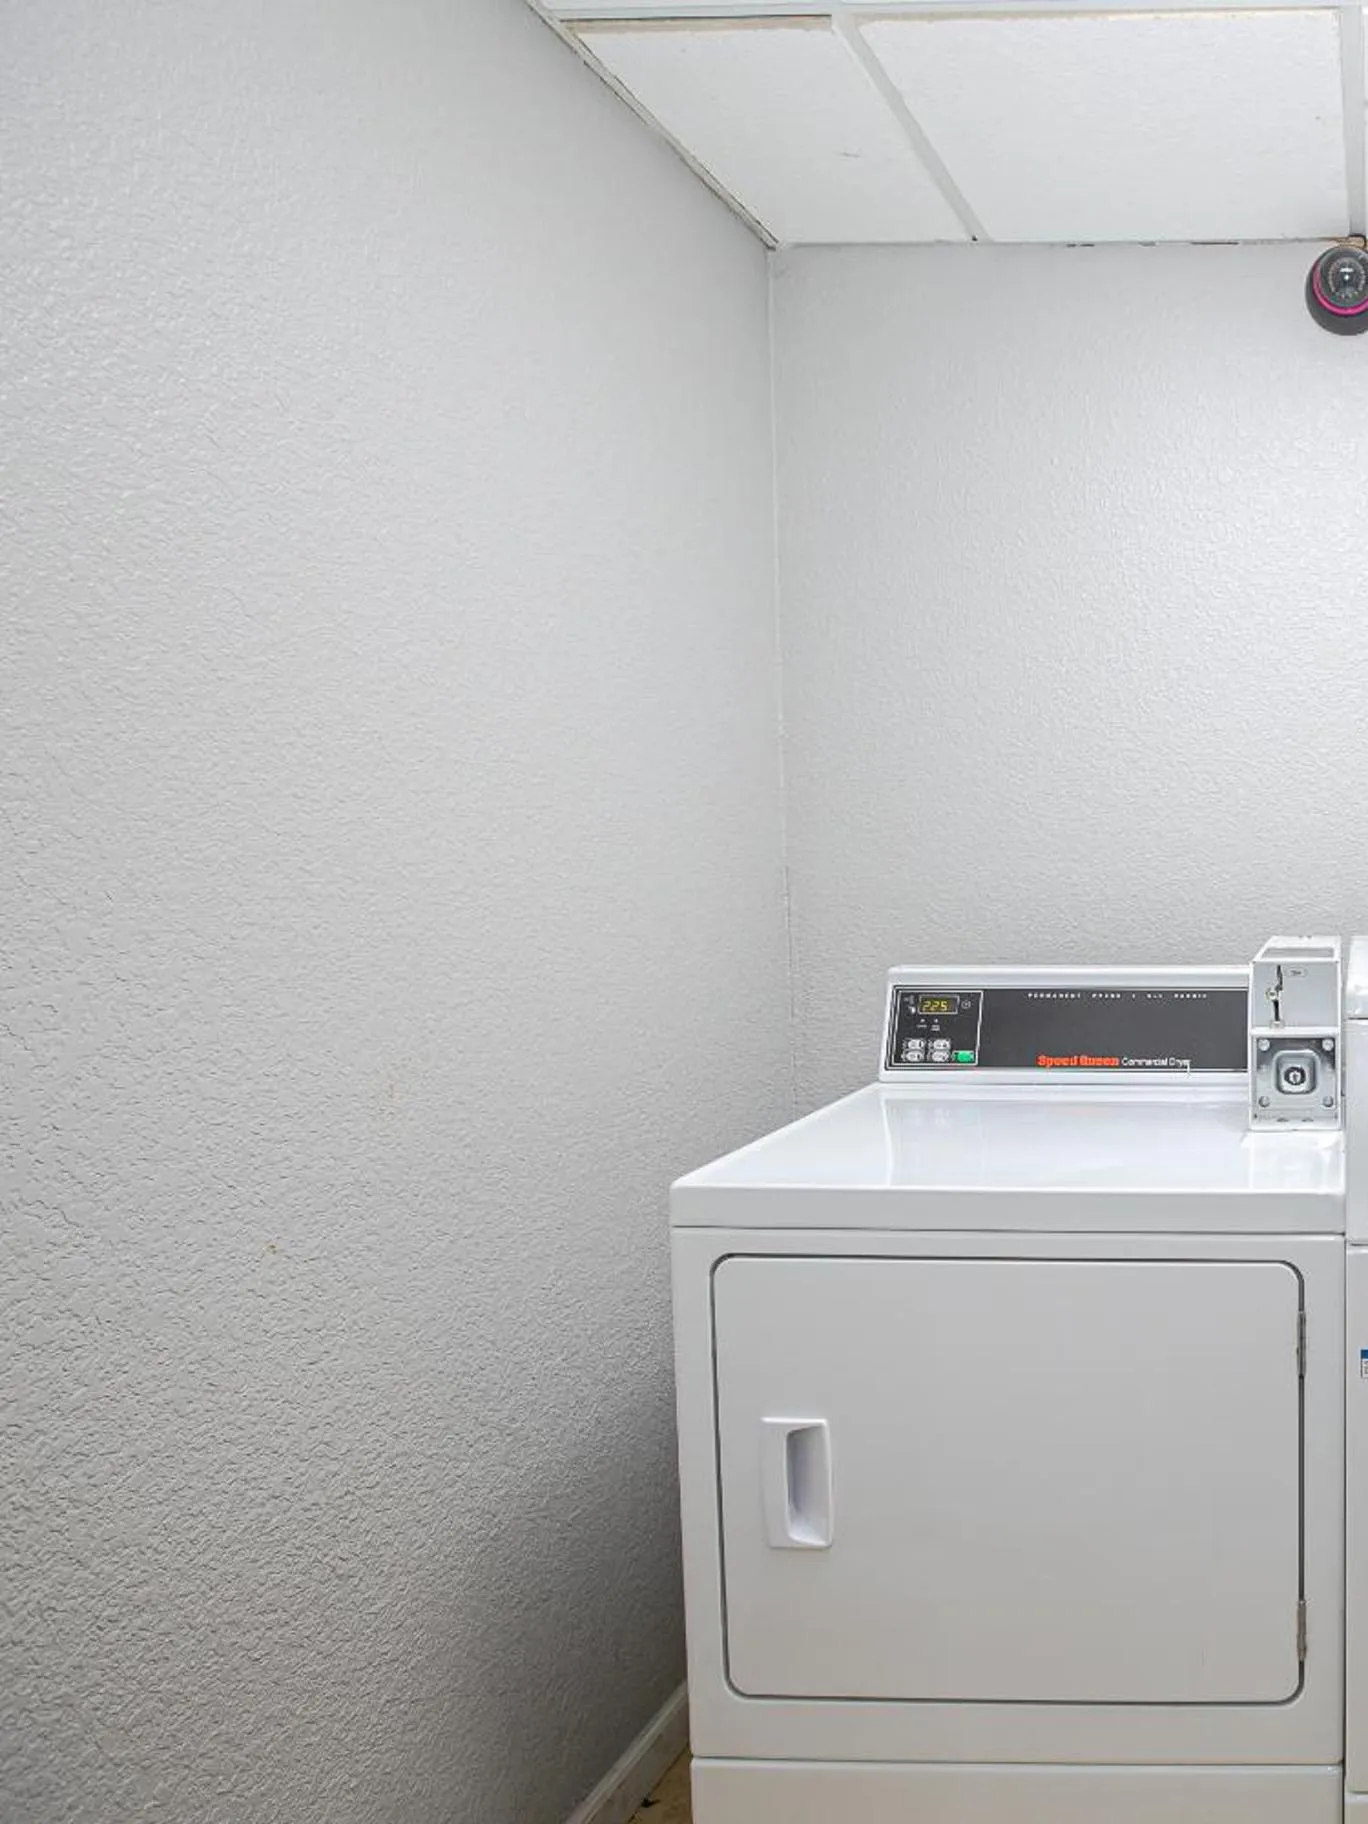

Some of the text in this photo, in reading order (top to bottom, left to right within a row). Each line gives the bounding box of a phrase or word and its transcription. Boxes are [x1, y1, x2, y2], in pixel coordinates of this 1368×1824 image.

[1037, 1054, 1079, 1069] Speed
[1080, 1054, 1120, 1067] Queen
[1121, 1056, 1168, 1067] Commercial
